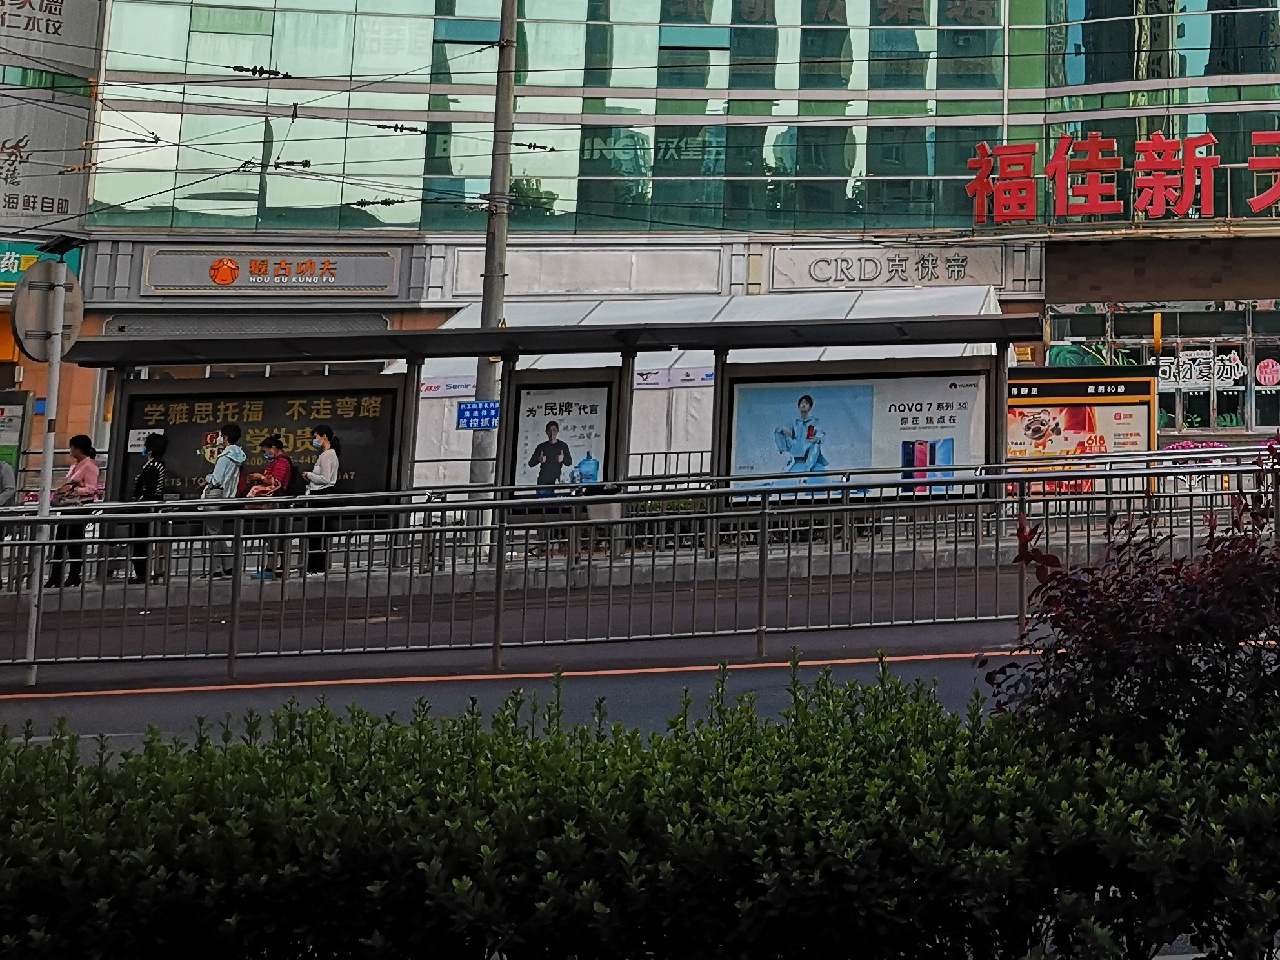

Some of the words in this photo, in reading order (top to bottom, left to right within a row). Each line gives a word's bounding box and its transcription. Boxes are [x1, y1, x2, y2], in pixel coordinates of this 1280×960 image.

[3, 193, 70, 215] 海鲜自助
[143, 400, 265, 426] 学雅思托福
[286, 396, 383, 422] 不走弯路
[888, 402, 923, 413] nova
[926, 402, 933, 412] 7
[936, 402, 954, 412] 系列
[1085, 434, 1106, 446] 618
